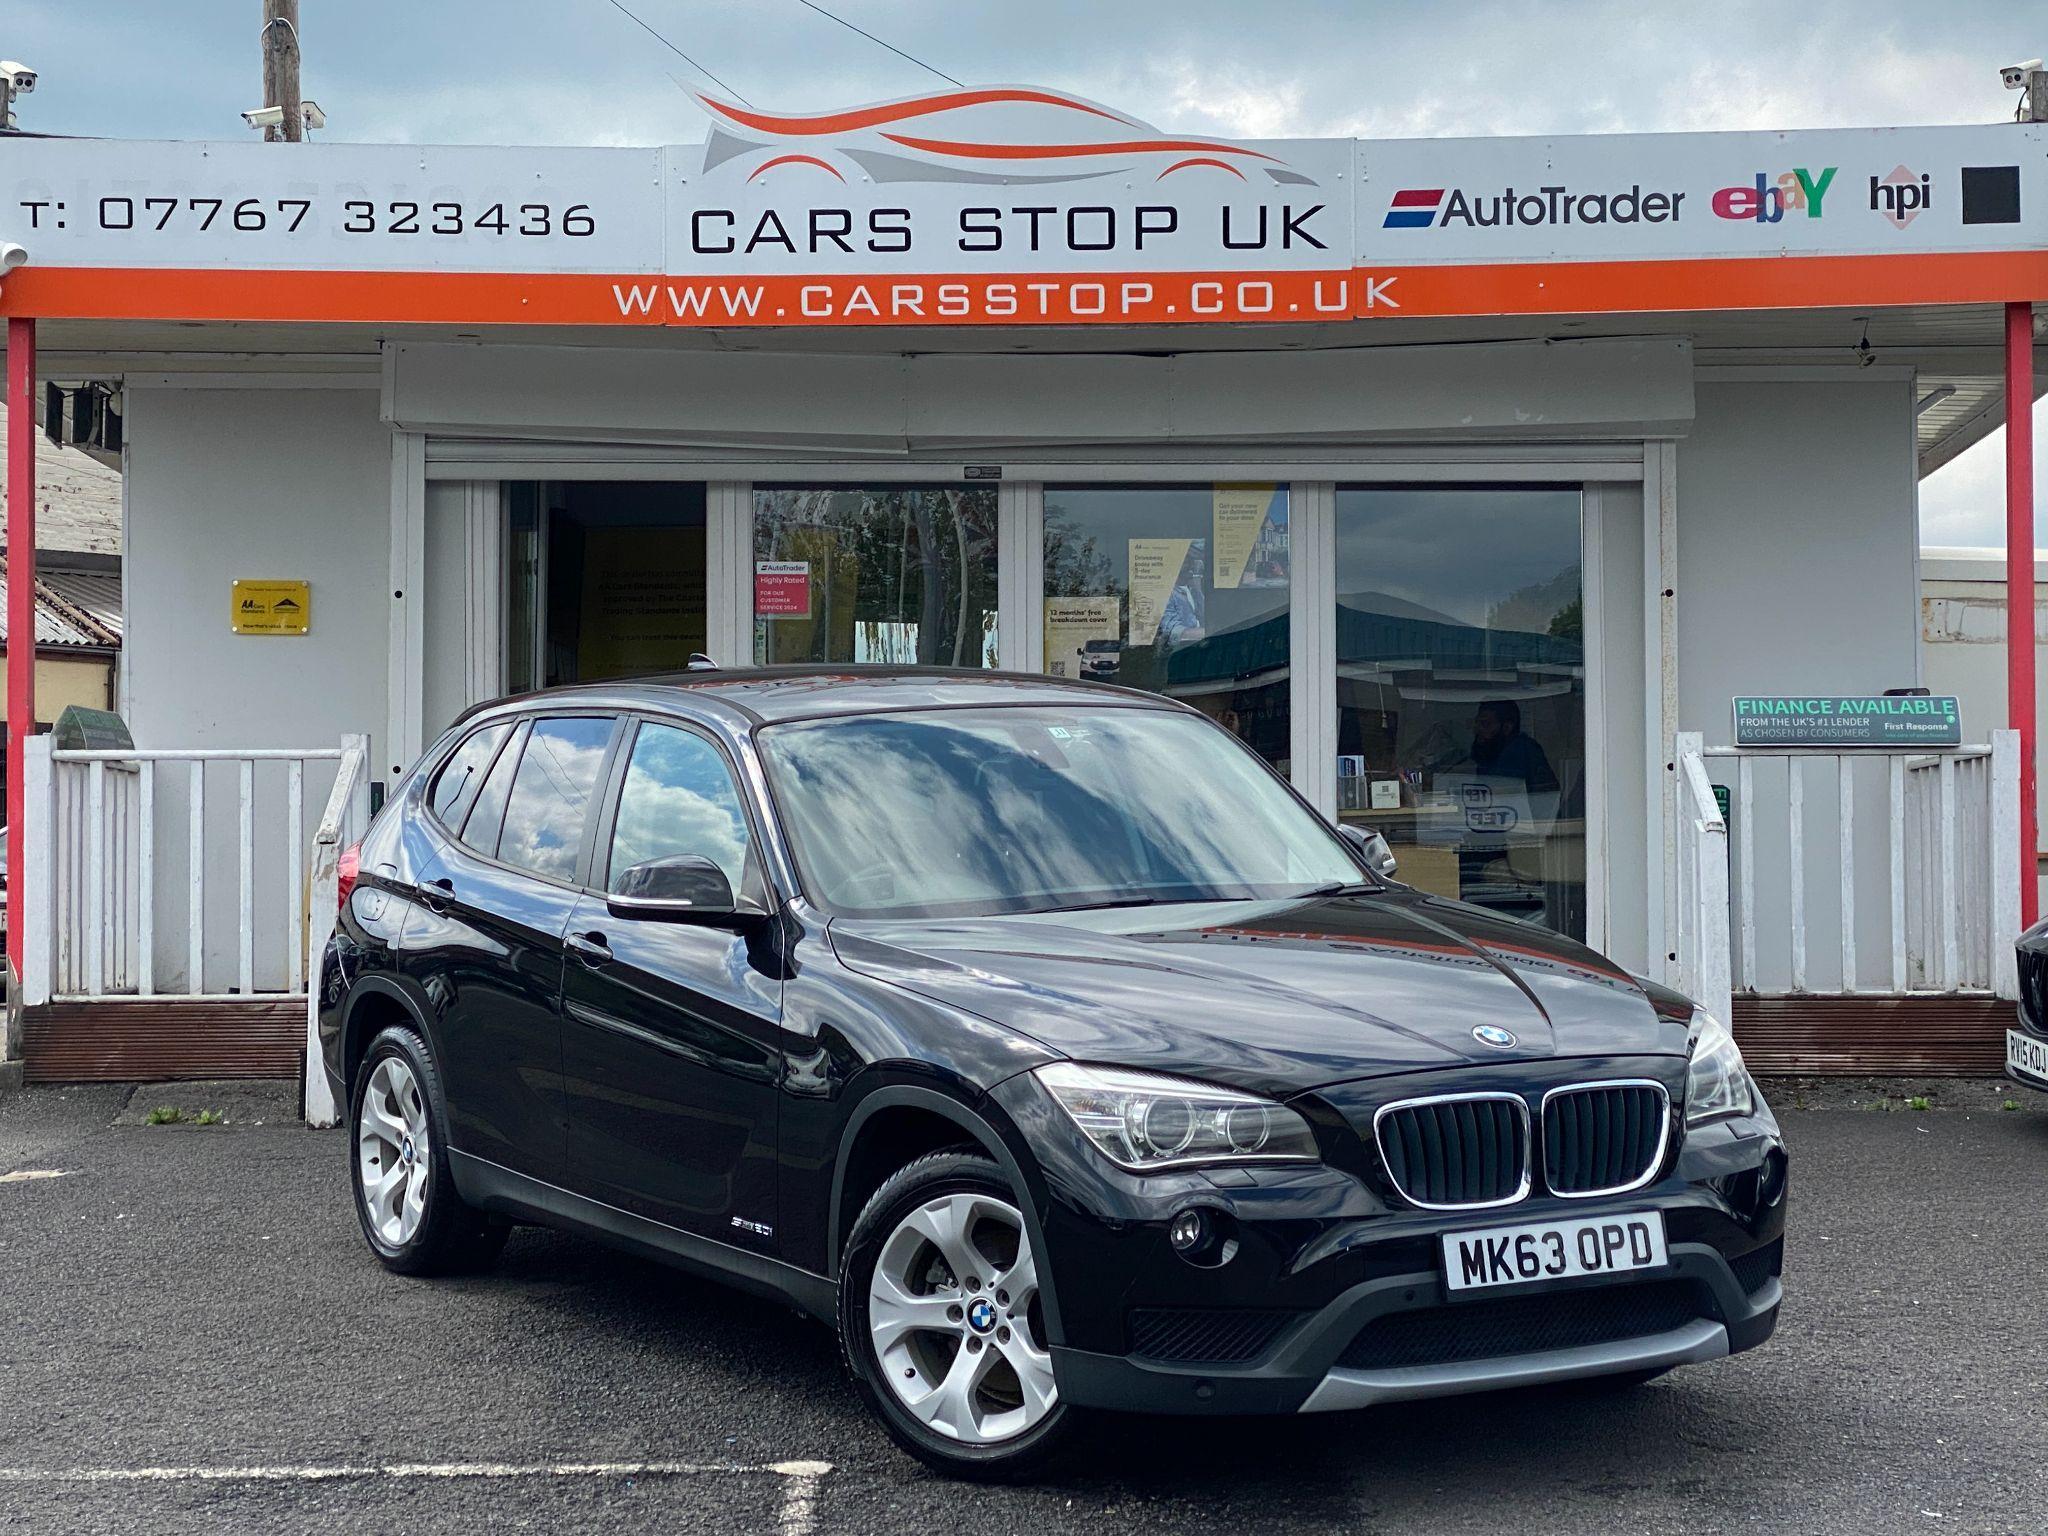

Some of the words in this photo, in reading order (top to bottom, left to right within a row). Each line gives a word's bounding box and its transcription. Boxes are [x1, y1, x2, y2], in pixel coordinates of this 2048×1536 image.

[1869, 173, 1930, 220] hpi
[1439, 184, 1686, 228] AutoTrader
[100, 198, 310, 232] 07767
[345, 201, 594, 236] 323436
[692, 209, 911, 253] CARS
[959, 206, 1177, 251] STOP
[1223, 205, 1328, 249] UK
[613, 277, 1399, 318] WWW.CARSSTOP.CO.UK
[767, 564, 806, 572] AutoTrader
[760, 576, 782, 585] Highly
[783, 576, 805, 584] Rated
[241, 599, 254, 609] AA
[1087, 609, 1102, 617] free
[1738, 699, 1834, 715] FINANCE
[1838, 699, 1956, 716] AVAILABLE
[1740, 717, 1769, 727] FROM
[1770, 717, 1790, 727] THE
[1792, 717, 1816, 727] UK'S
[1817, 717, 1829, 727] #1
[1831, 717, 1870, 727] LENDER
[1884, 722, 1904, 731] First
[1906, 722, 1949, 732] Response
[1740, 728, 1754, 738] AS
[1754, 728, 1796, 738] CHOSEN
[1797, 728, 1809, 738] BY
[1811, 728, 1870, 738] CONSUMERS
[1459, 1231, 1567, 1285] MK63
[1577, 1222, 1653, 1272] OPD
